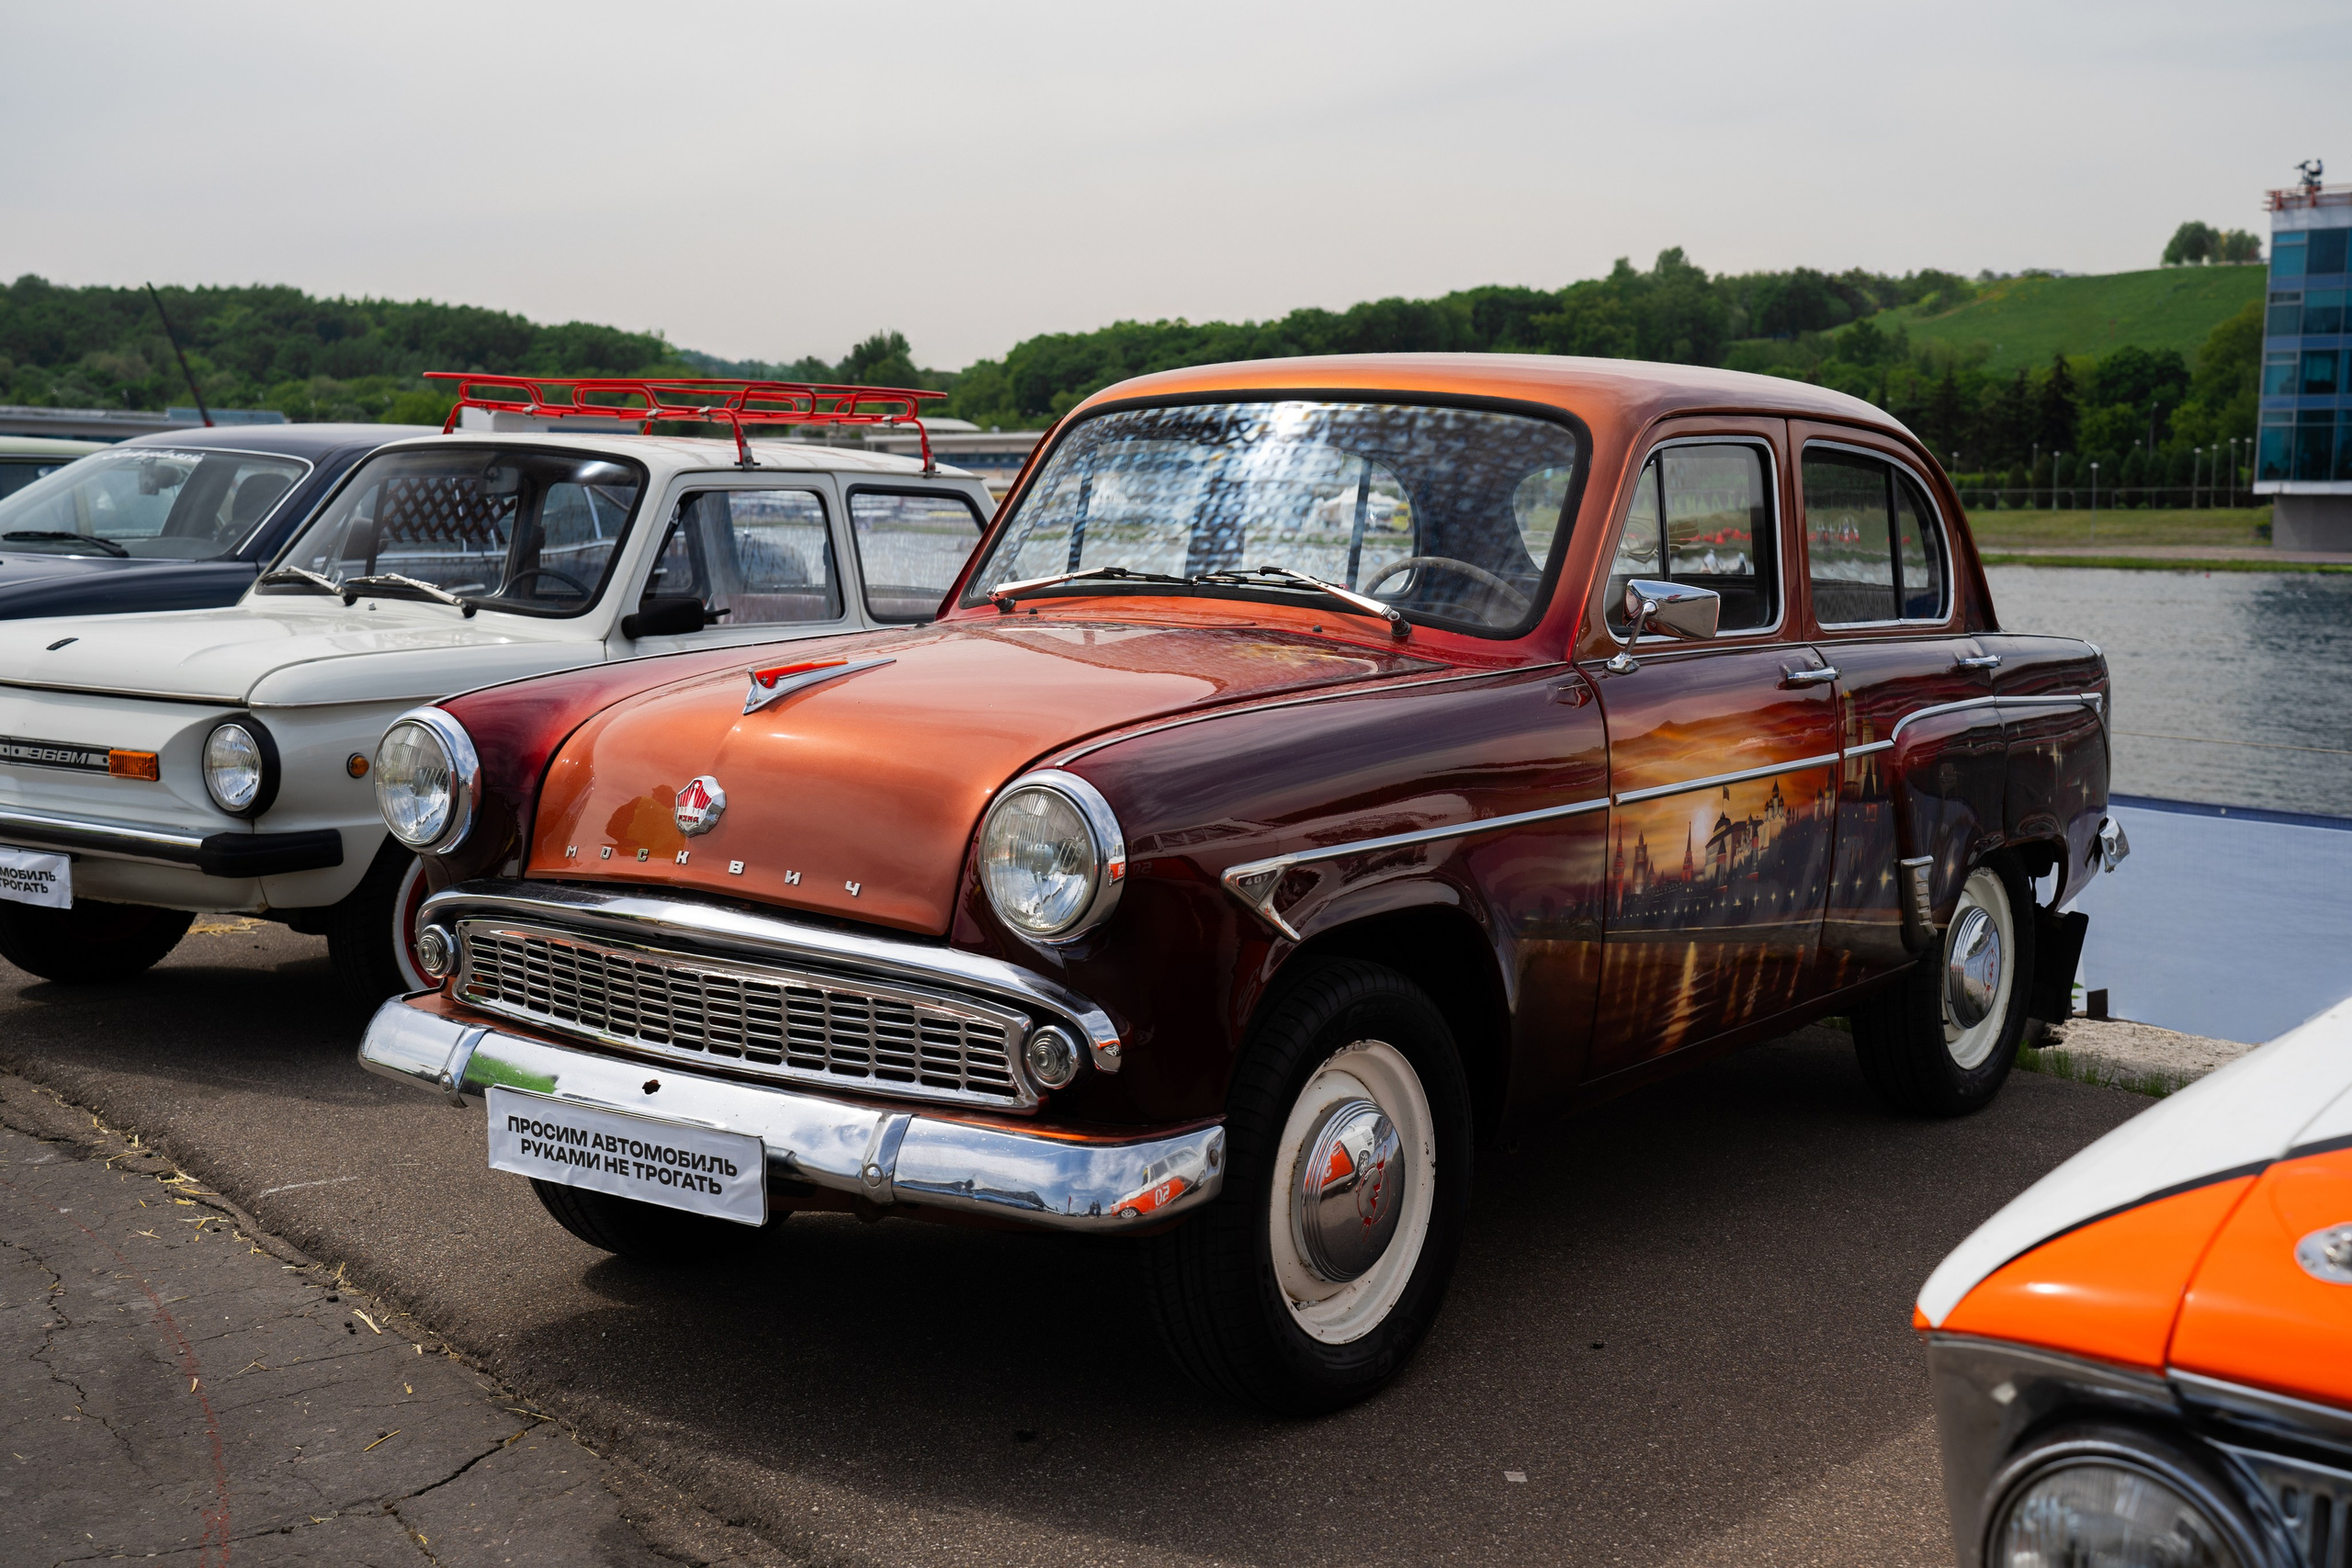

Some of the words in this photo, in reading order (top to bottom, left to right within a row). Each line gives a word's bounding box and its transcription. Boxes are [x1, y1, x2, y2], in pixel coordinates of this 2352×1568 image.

[0, 878, 49, 894] РОГАТЬ
[565, 845, 860, 897] МОСКВИЧ
[1245, 874, 1269, 886] 407
[508, 1115, 588, 1147] ПРОСИМ
[592, 1133, 739, 1178] АВТОМОБИЛЬ
[521, 1138, 600, 1170] РУКАМИ
[604, 1156, 629, 1177] НЕ
[633, 1162, 723, 1195] ТРОГАТЬ
